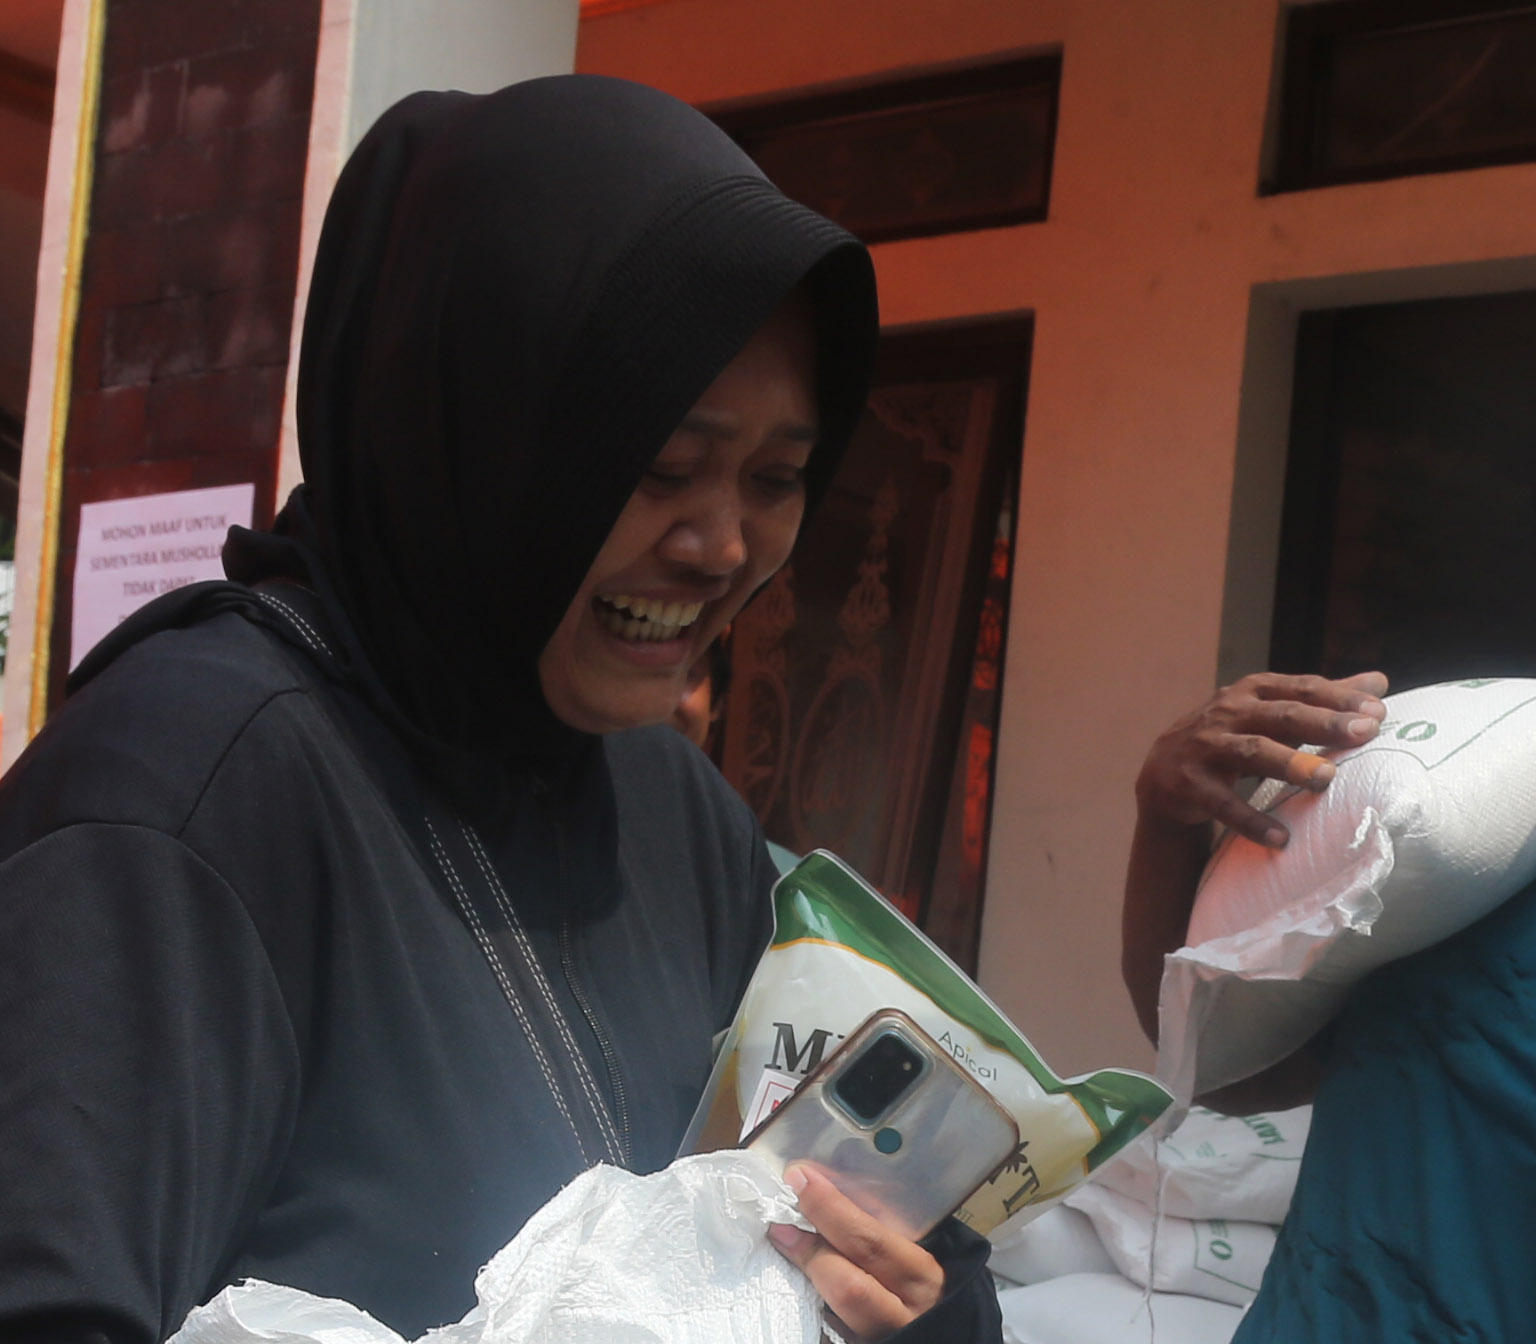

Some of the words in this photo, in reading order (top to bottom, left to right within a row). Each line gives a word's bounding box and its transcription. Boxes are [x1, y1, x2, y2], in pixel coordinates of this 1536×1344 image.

[101, 524, 146, 542] MOHON
[150, 520, 183, 537] MAAF
[186, 515, 226, 533] UNTUK
[91, 551, 157, 570] SEMENTARA
[122, 580, 156, 598] TIDAK
[938, 1031, 997, 1082] Apical
